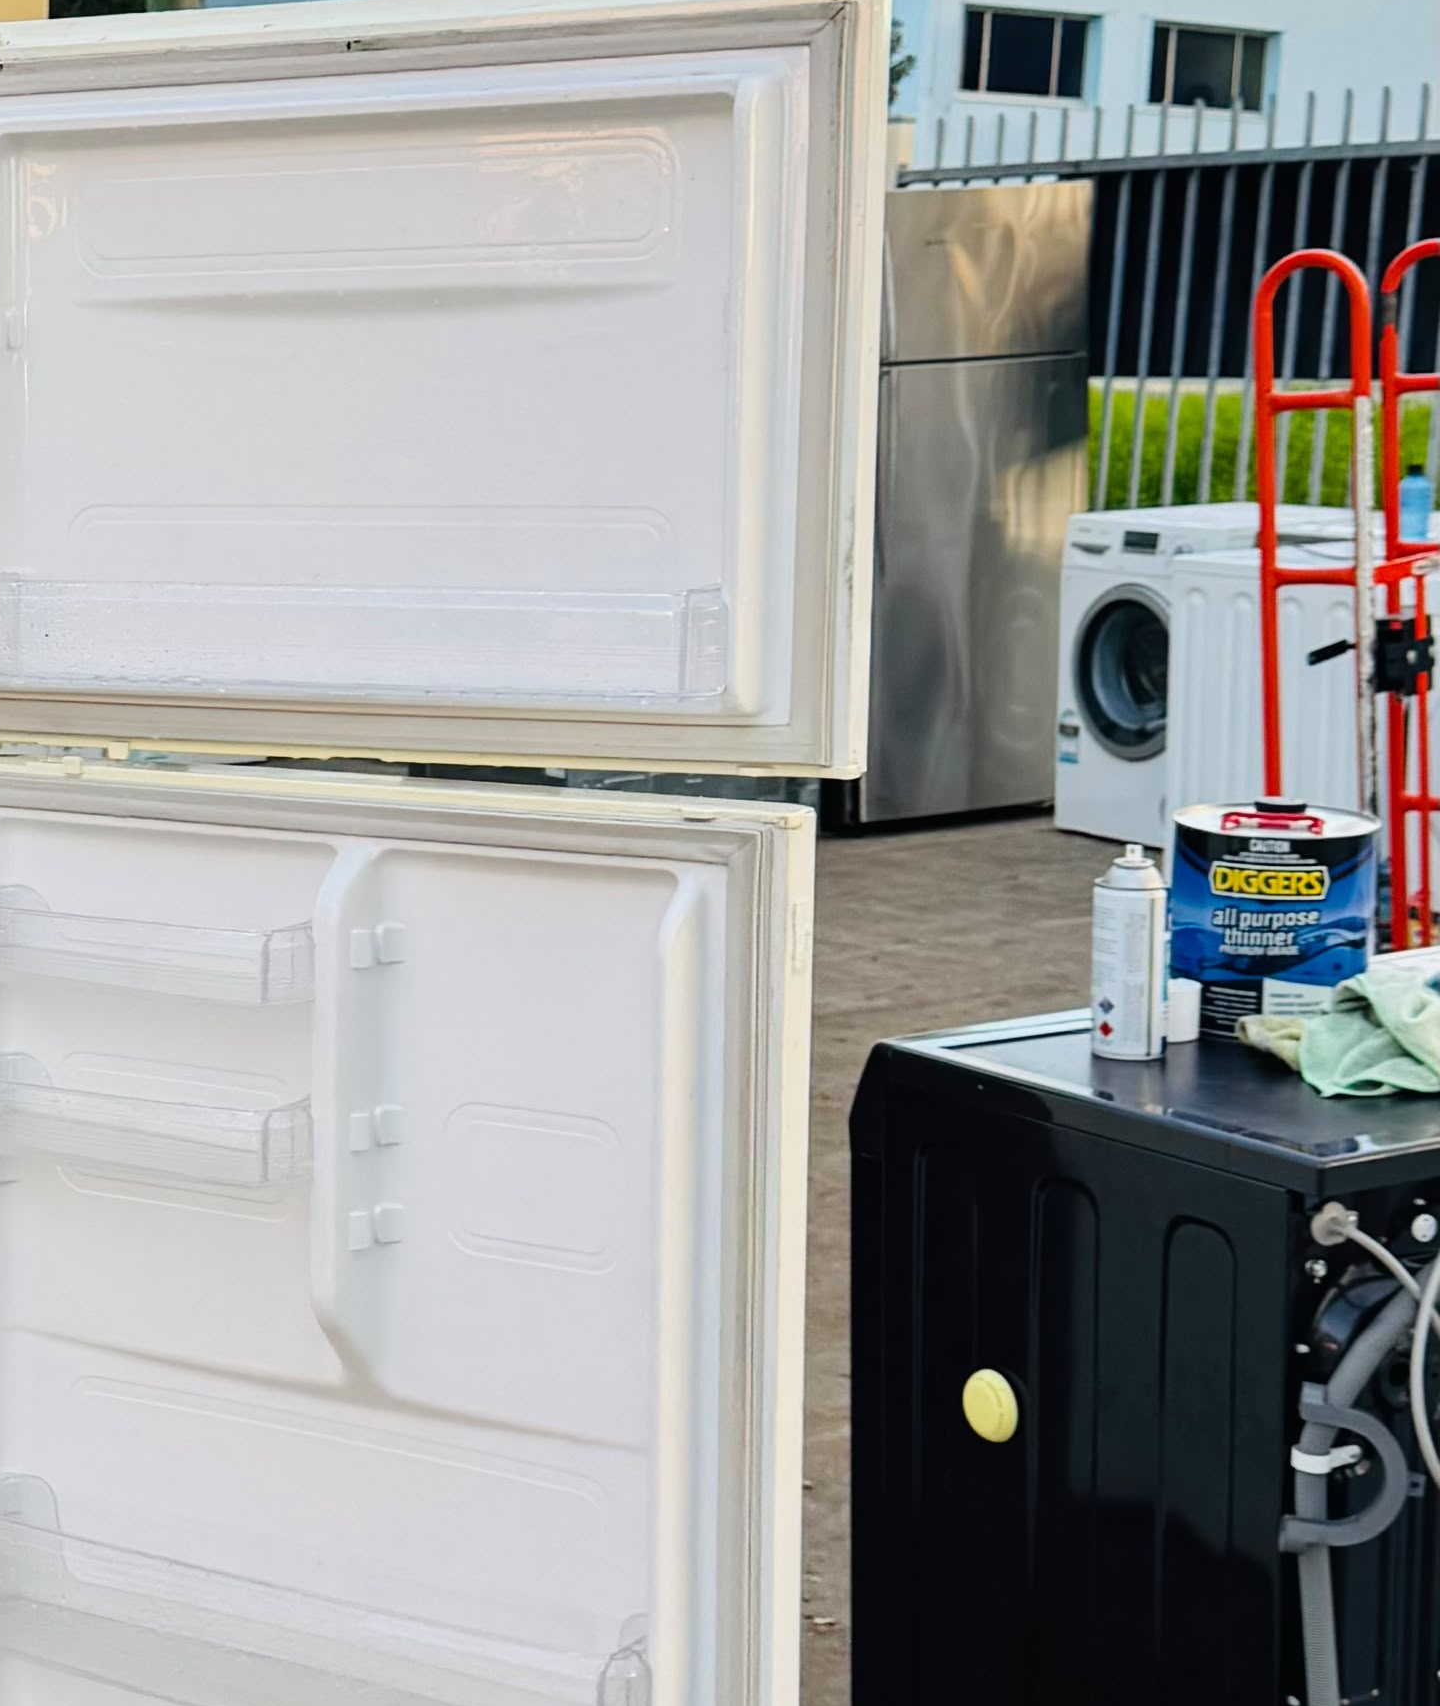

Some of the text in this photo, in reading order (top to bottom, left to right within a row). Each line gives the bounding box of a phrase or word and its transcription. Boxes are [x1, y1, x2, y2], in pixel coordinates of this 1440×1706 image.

[1215, 867, 1323, 896] DIGGERS
[1212, 907, 1320, 930] all purpose
[1224, 927, 1296, 946] thinner
